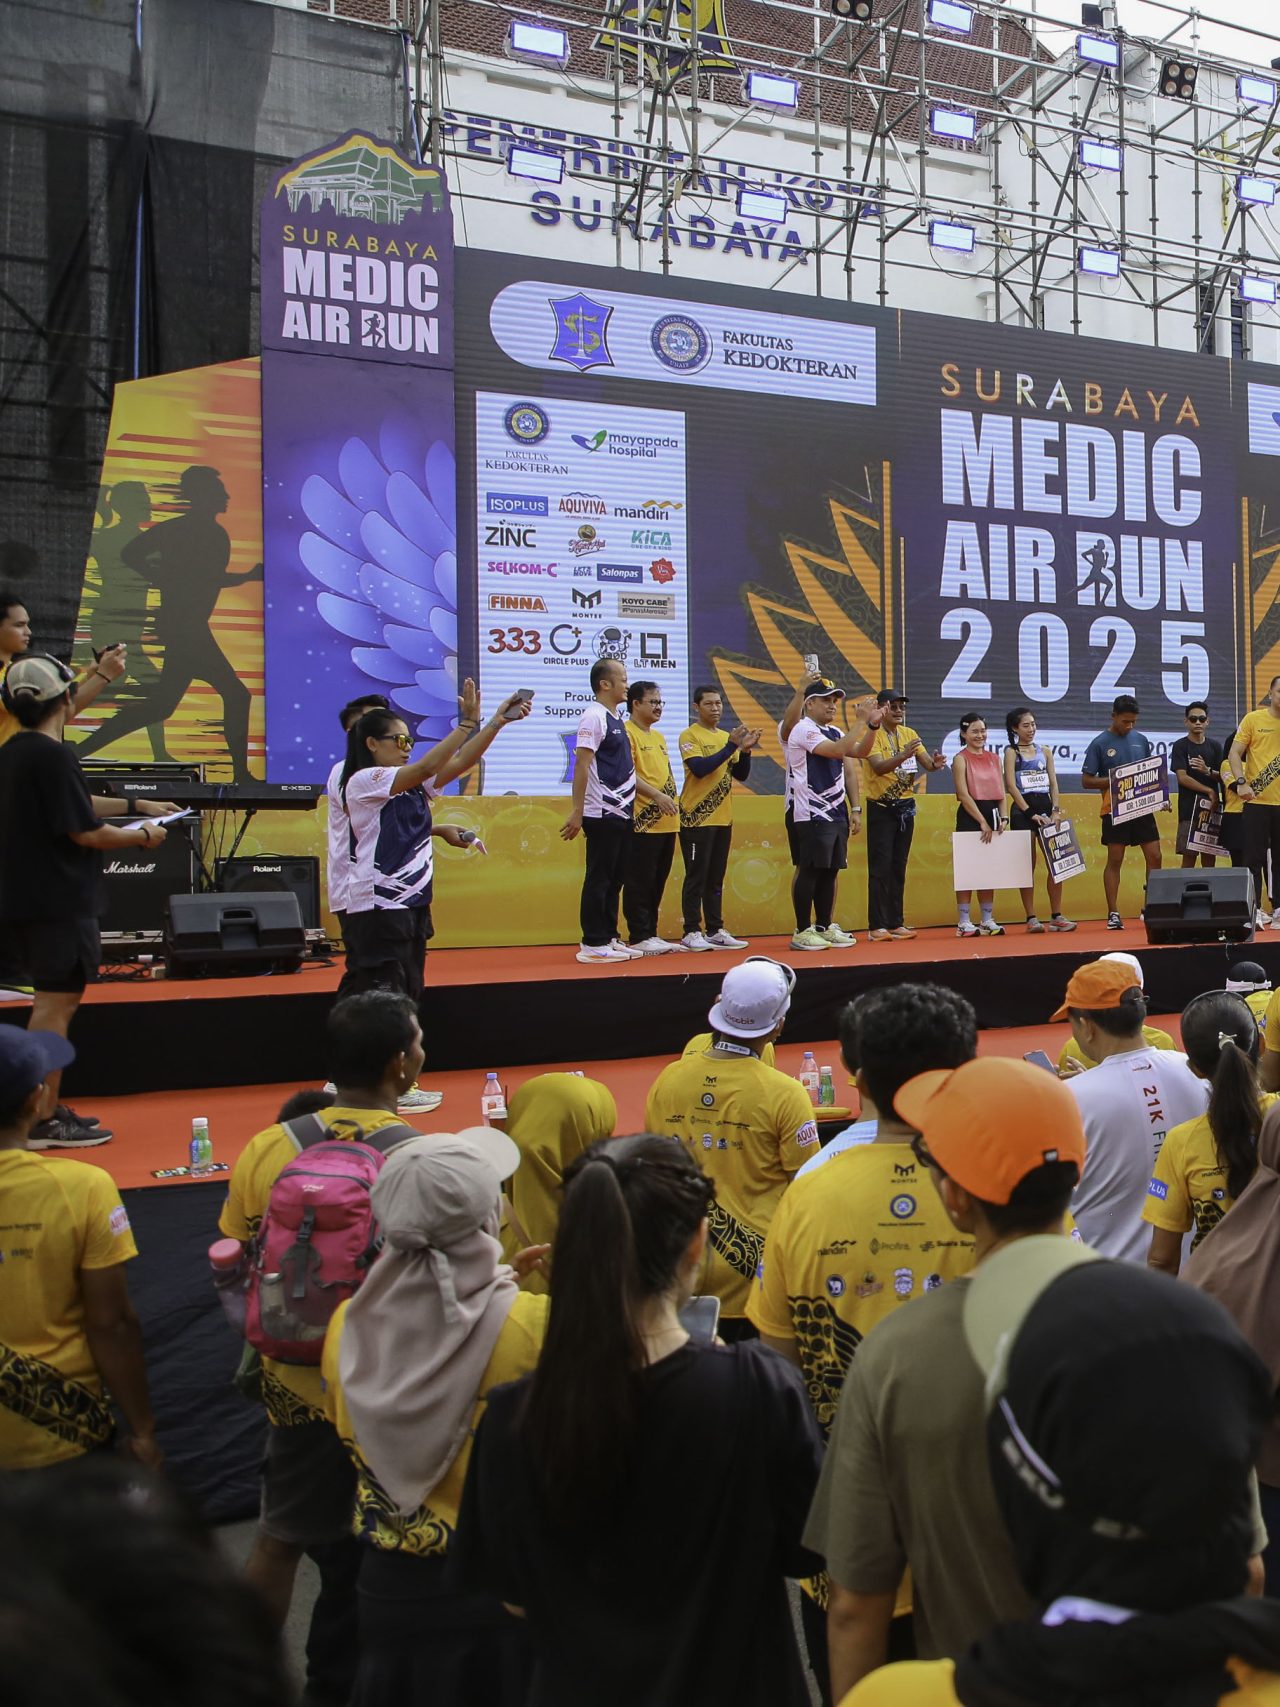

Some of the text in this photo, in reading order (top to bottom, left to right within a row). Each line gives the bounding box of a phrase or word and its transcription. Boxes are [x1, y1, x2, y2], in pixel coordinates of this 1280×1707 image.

[531, 190, 808, 265] SURABAYA
[283, 225, 438, 262] SURABAYA
[282, 246, 439, 312] MEDIC
[281, 300, 440, 355] AIR RUN
[722, 330, 794, 351] FAKULTAS
[722, 349, 857, 380] KEDOKTERAN
[940, 362, 1200, 428] SURABAYA
[609, 433, 679, 449] mayapada
[609, 444, 657, 459] hospital
[485, 459, 569, 475] KEDOKTERAN
[940, 407, 1202, 528] MEDIC
[490, 498, 545, 512] ISOPLUS
[558, 498, 607, 515] AQUVIVA
[614, 506, 669, 520] mandiri
[485, 526, 537, 548] ZINC
[487, 561, 558, 578] SELKOM-C
[601, 567, 639, 579] Salonpas
[939, 519, 1204, 613] AIR RUN
[491, 596, 545, 611] FINNA
[622, 598, 645, 606] KOYO
[487, 627, 542, 654] 333
[543, 657, 569, 666] CIRCLE
[570, 658, 590, 666] PLUS
[634, 659, 650, 668] LT
[650, 660, 677, 669] MEN
[939, 607, 1210, 706] 2025
[1133, 769, 1159, 788] PODIUM
[103, 861, 156, 874] Marshall
[252, 865, 281, 873] Roland
[1143, 1085, 1165, 1125] 21K
